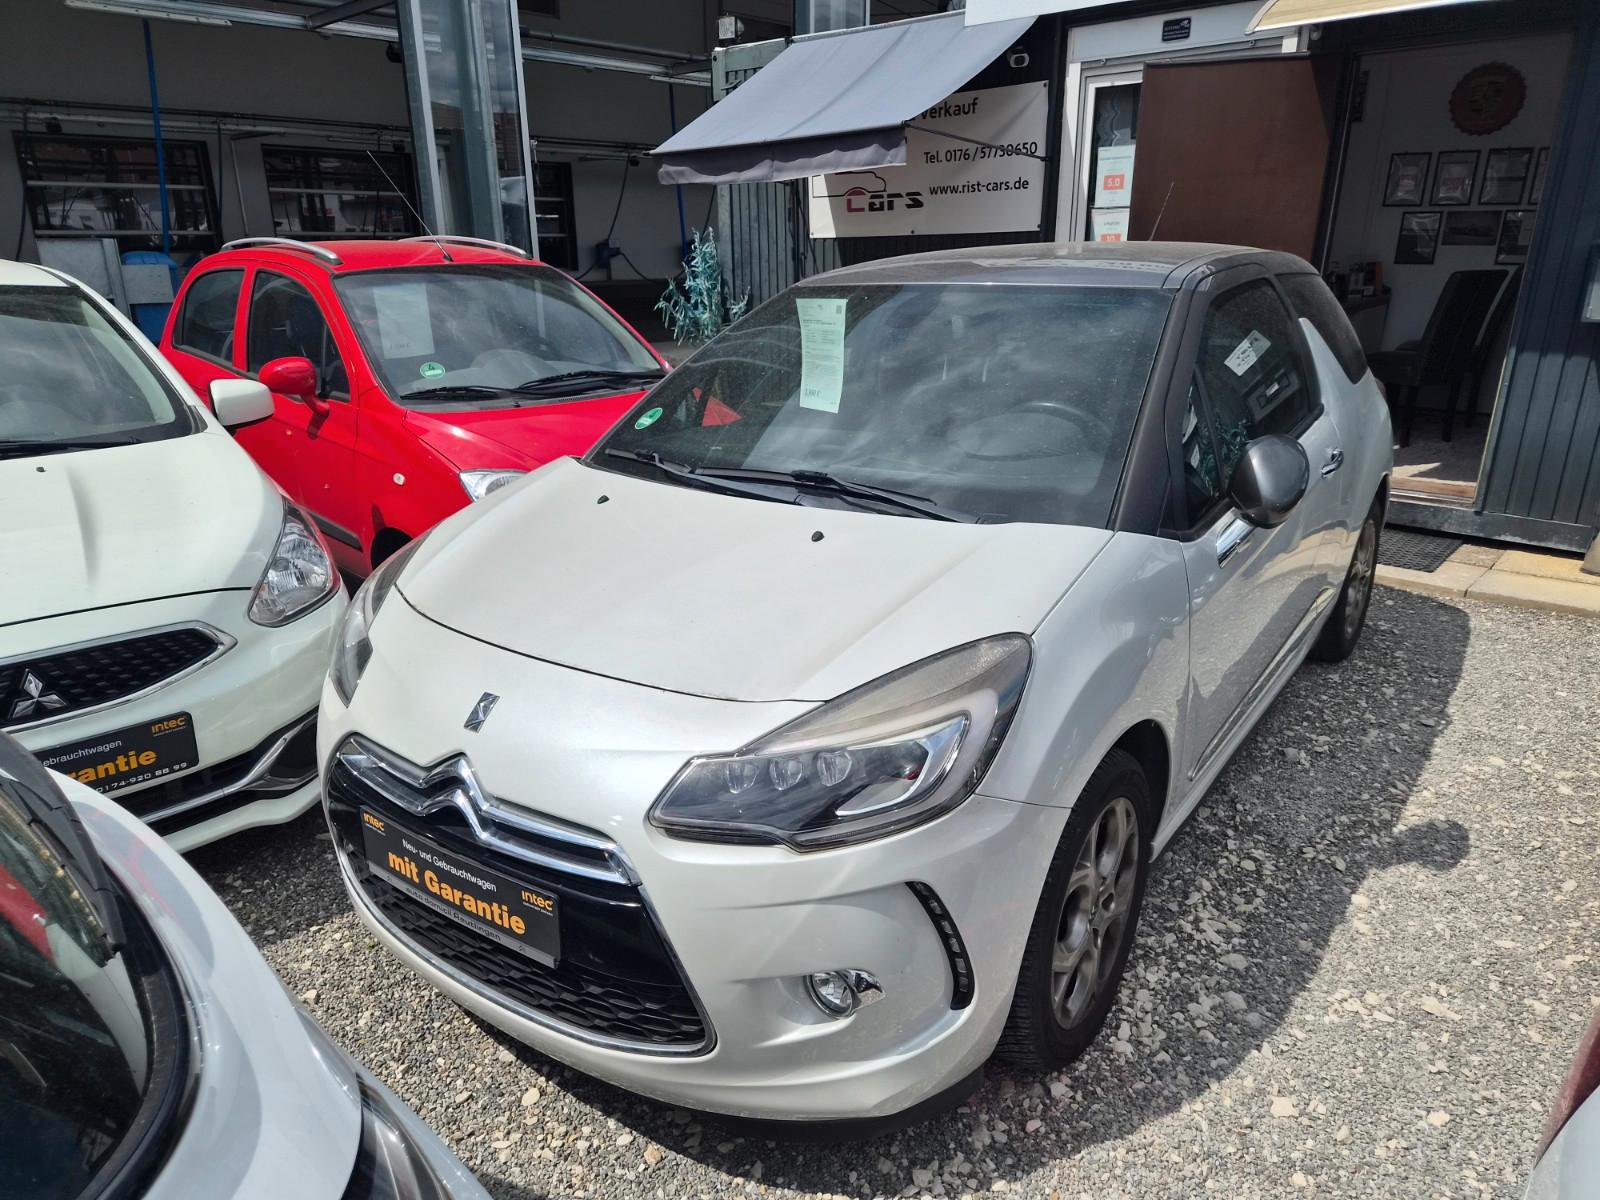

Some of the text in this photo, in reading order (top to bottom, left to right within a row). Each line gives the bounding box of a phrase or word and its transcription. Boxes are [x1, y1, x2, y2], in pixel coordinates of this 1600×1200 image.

[924, 151, 942, 164] Tel.
[929, 177, 1029, 196] www.rist-cars.de
[42, 740, 122, 767] ebrauchtwagen
[402, 838, 497, 892] Neu- und Gebrauchtwagen
[388, 851, 527, 935] mit Garantie
